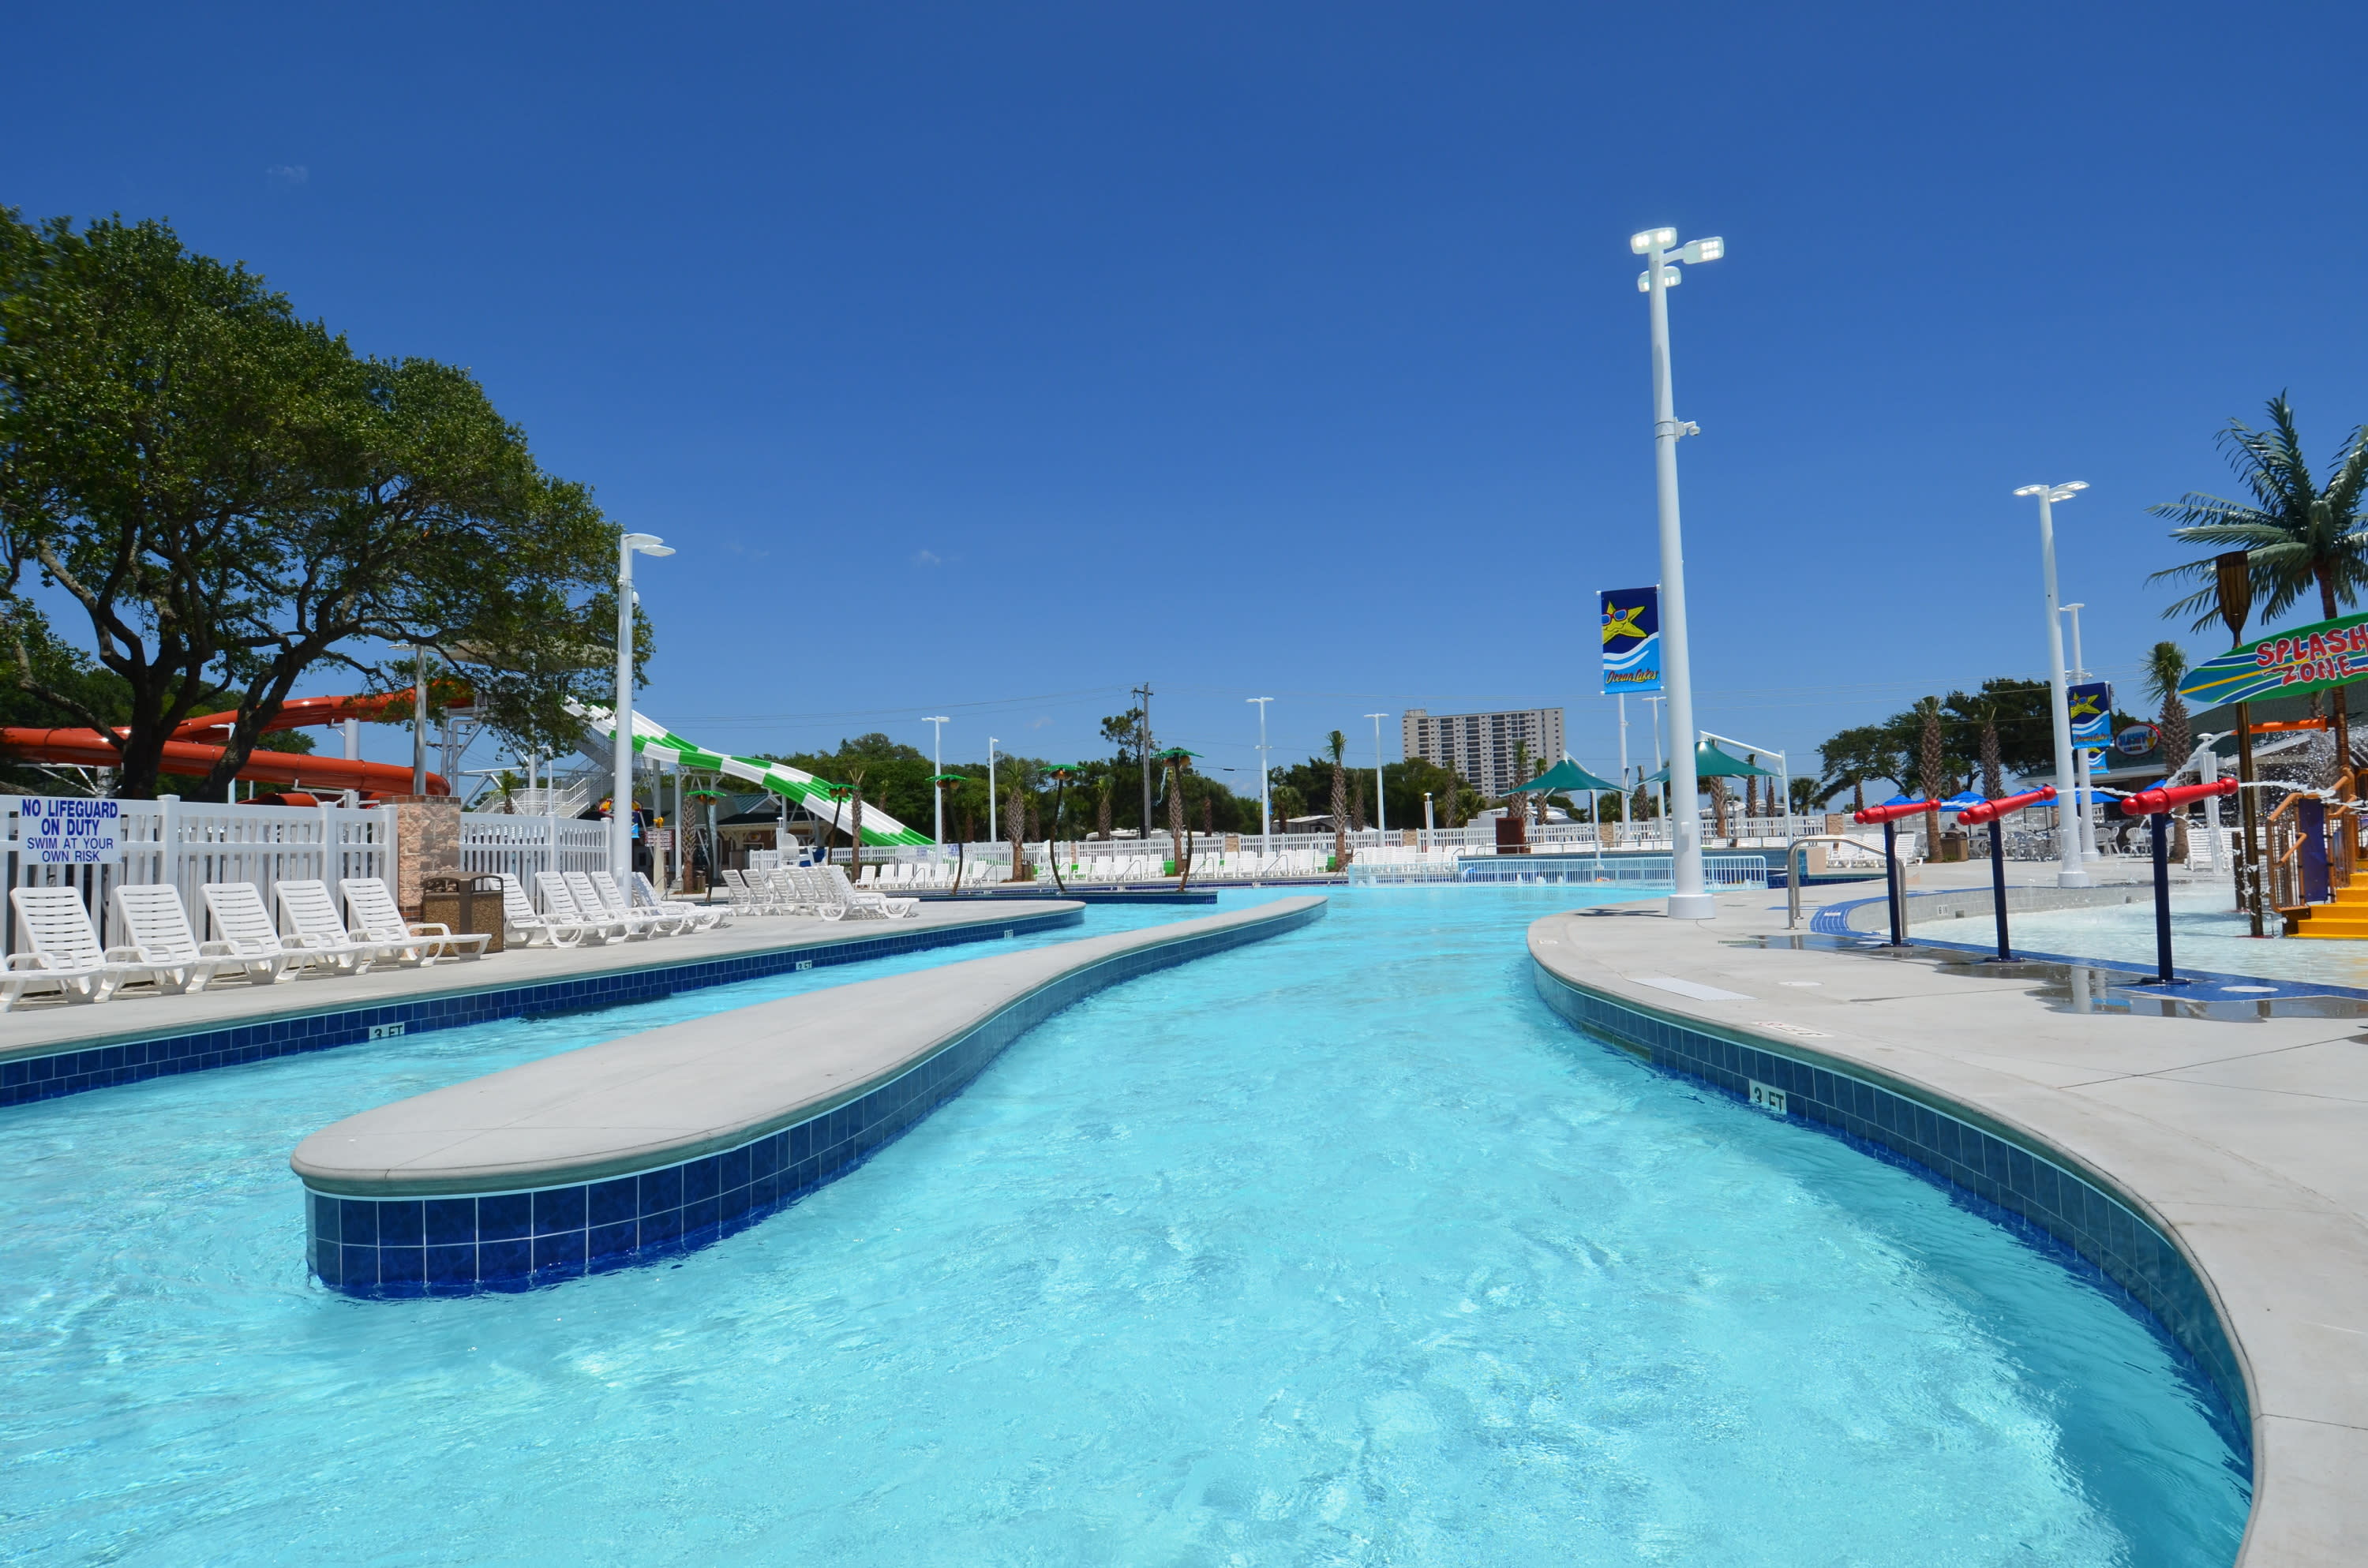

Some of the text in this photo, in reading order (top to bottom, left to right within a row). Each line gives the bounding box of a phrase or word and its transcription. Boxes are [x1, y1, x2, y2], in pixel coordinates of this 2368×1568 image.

[2256, 623, 2368, 667] SPLASH
[1606, 668, 1659, 684] Ocean Lakes
[2262, 654, 2368, 687] ZONE
[22, 799, 118, 818] NO LIFEGUARD
[41, 818, 99, 836] ON DUTY
[27, 837, 114, 849] SWIM AT YOUR
[42, 851, 100, 863] OWN RISK
[388, 1025, 403, 1036] FT
[1754, 1087, 1784, 1111] 3 FT
